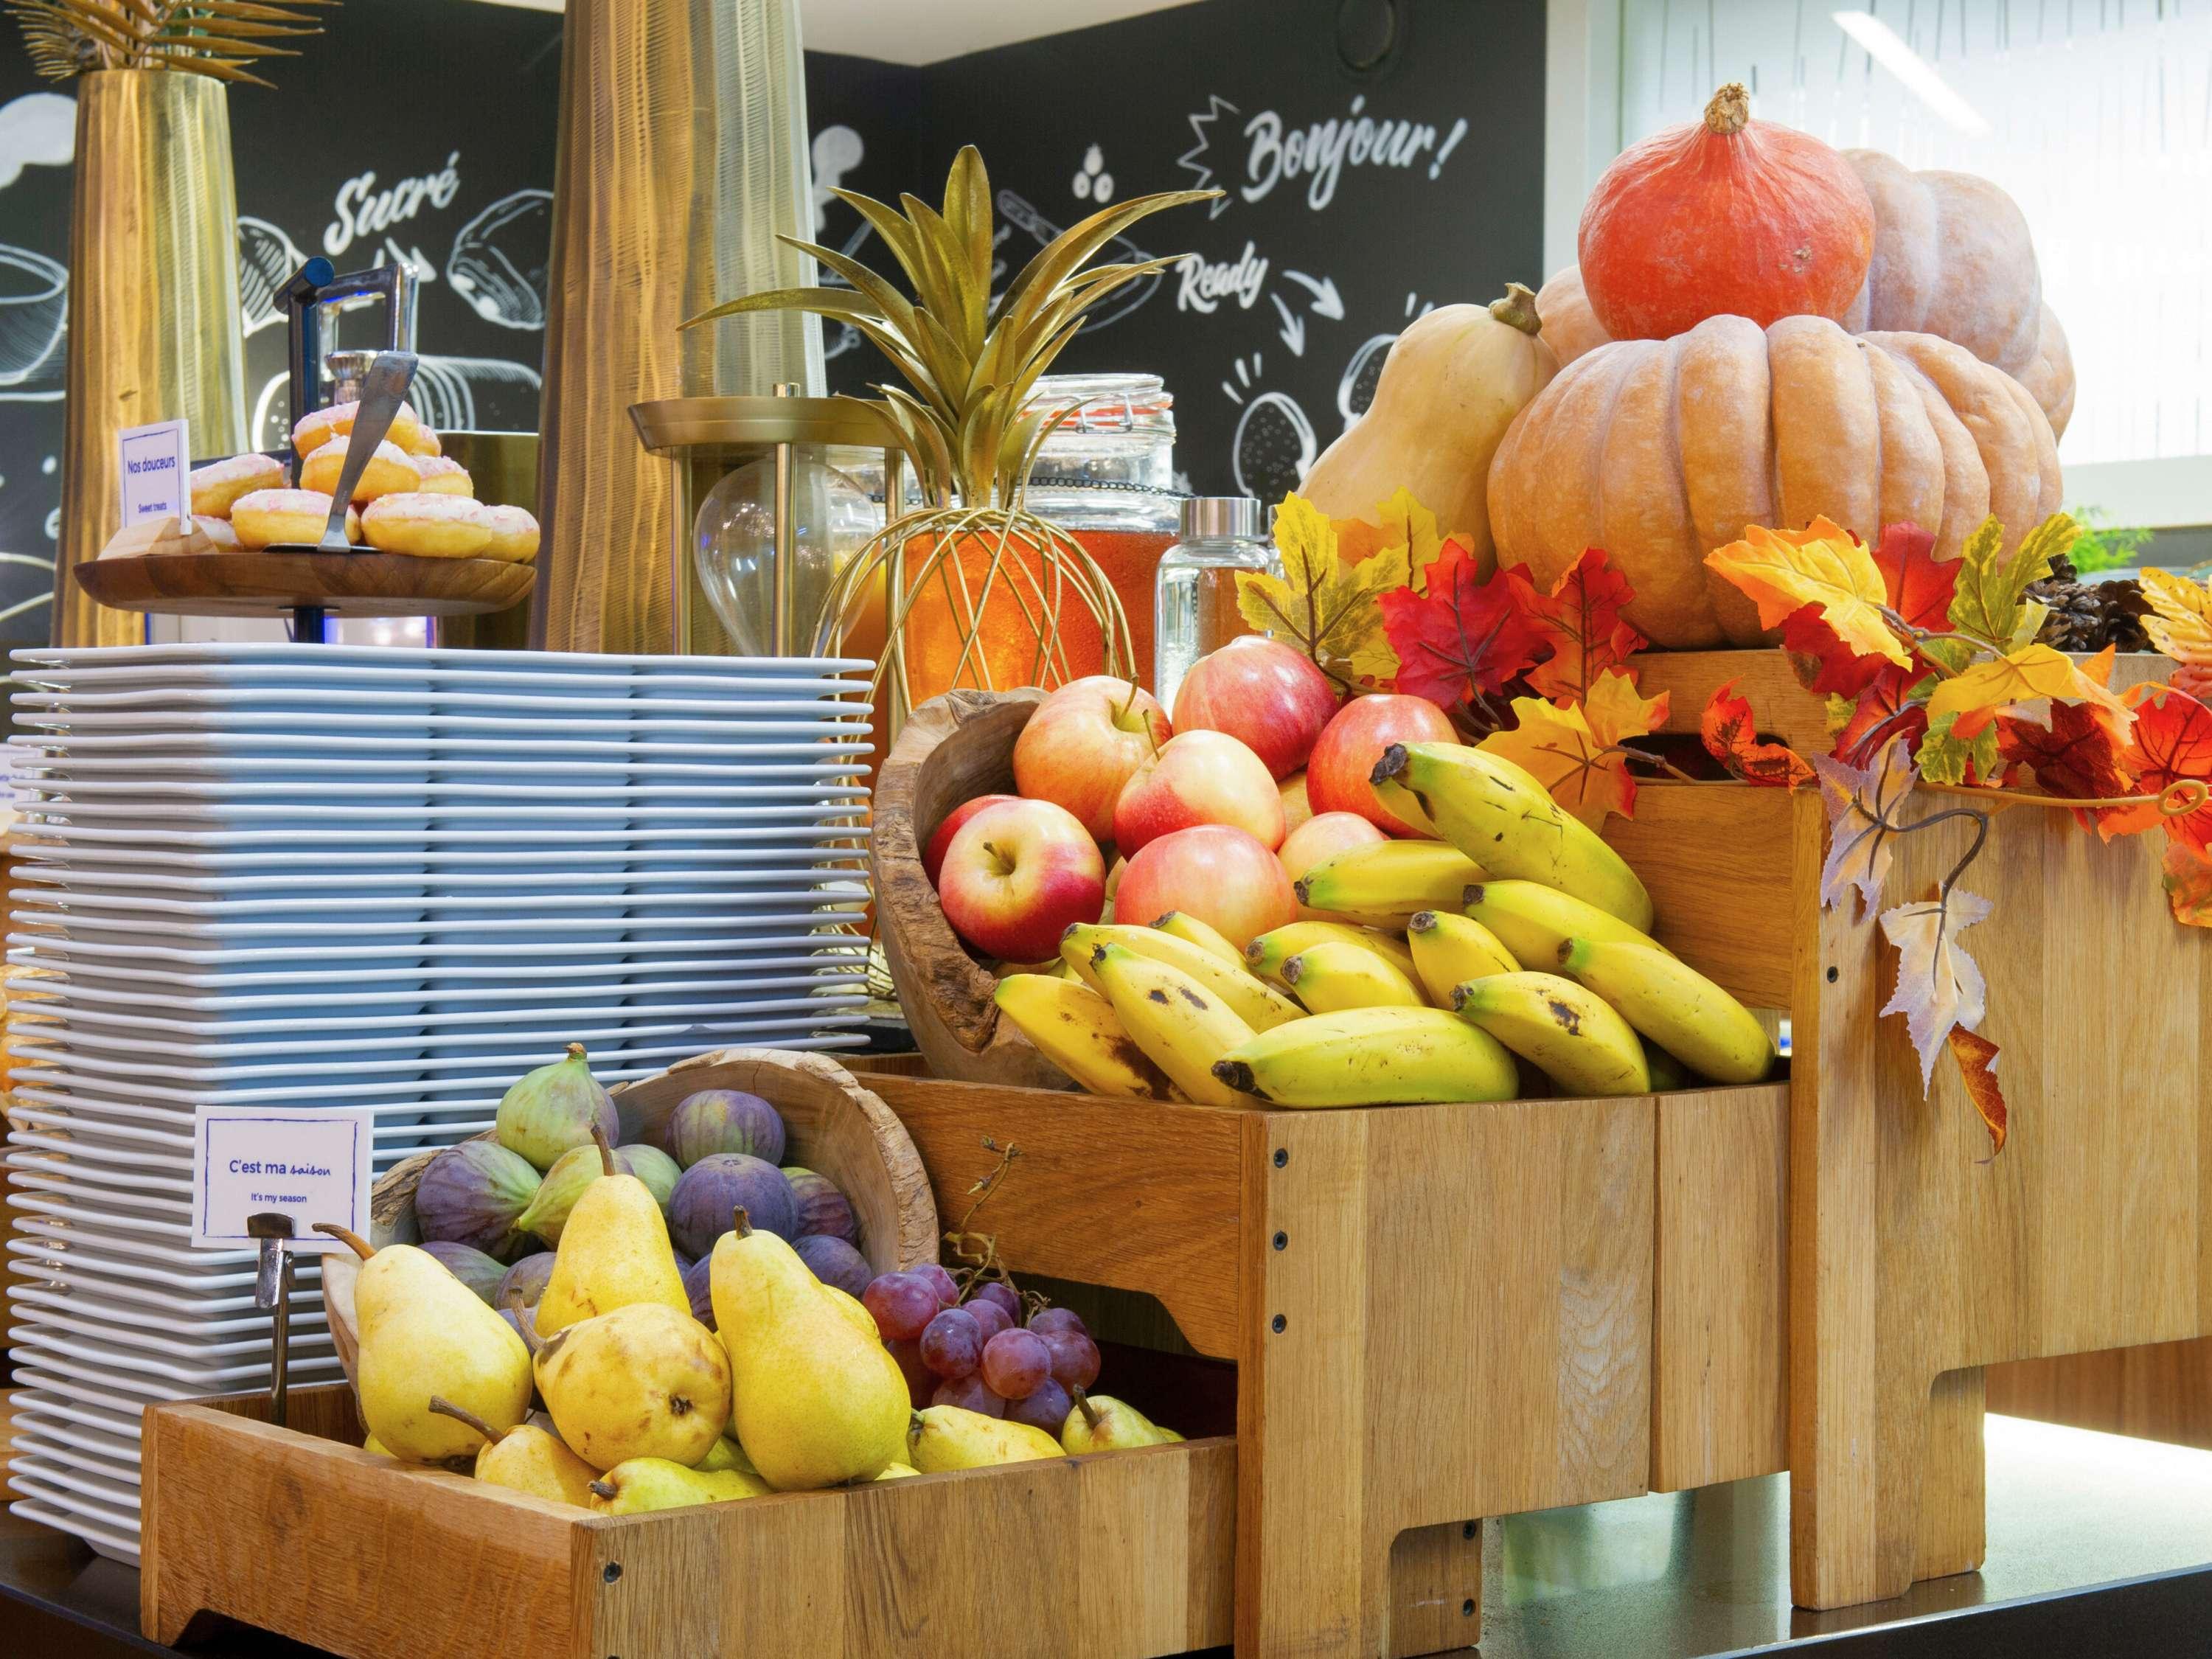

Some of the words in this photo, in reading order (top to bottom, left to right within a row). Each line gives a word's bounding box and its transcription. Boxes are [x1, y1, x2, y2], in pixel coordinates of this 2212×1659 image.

[323, 150, 461, 257] Sucré
[1175, 240, 1269, 314] Ready
[128, 459, 141, 474] Nos
[142, 456, 175, 472] douceurs
[138, 504, 153, 513] Sweet
[153, 501, 167, 511] treats
[229, 1159, 261, 1174] C'est
[265, 1164, 286, 1175] ma
[290, 1163, 330, 1176] saison
[251, 1192, 262, 1202] It's
[265, 1194, 277, 1203] my
[279, 1195, 307, 1203] season
